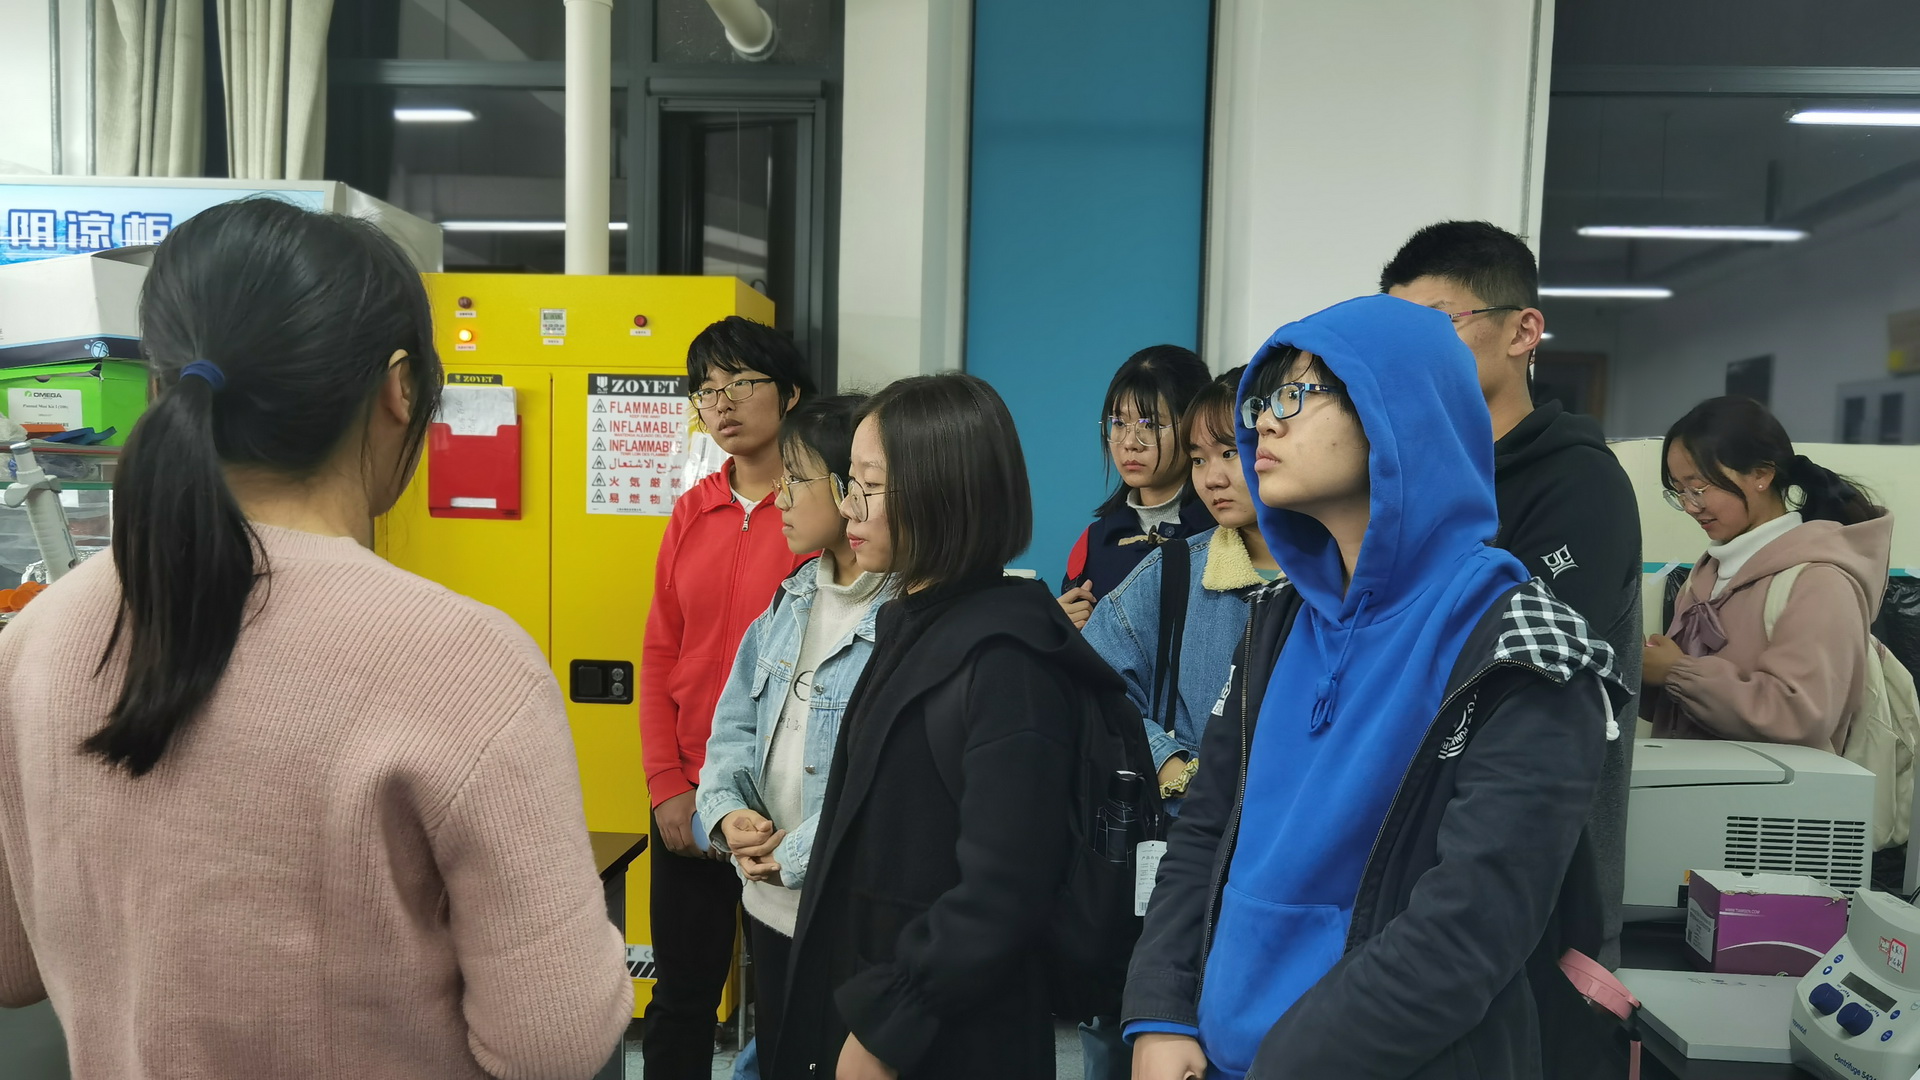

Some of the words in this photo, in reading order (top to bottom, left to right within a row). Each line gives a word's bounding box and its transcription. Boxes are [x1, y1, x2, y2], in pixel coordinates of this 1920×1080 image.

[9, 209, 172, 250] 阴凉柜
[462, 375, 494, 383] ZOYET
[611, 379, 679, 394] ZOYET
[609, 401, 683, 415] FLAMMABLE
[1834, 1053, 1862, 1077] Centrifuge
